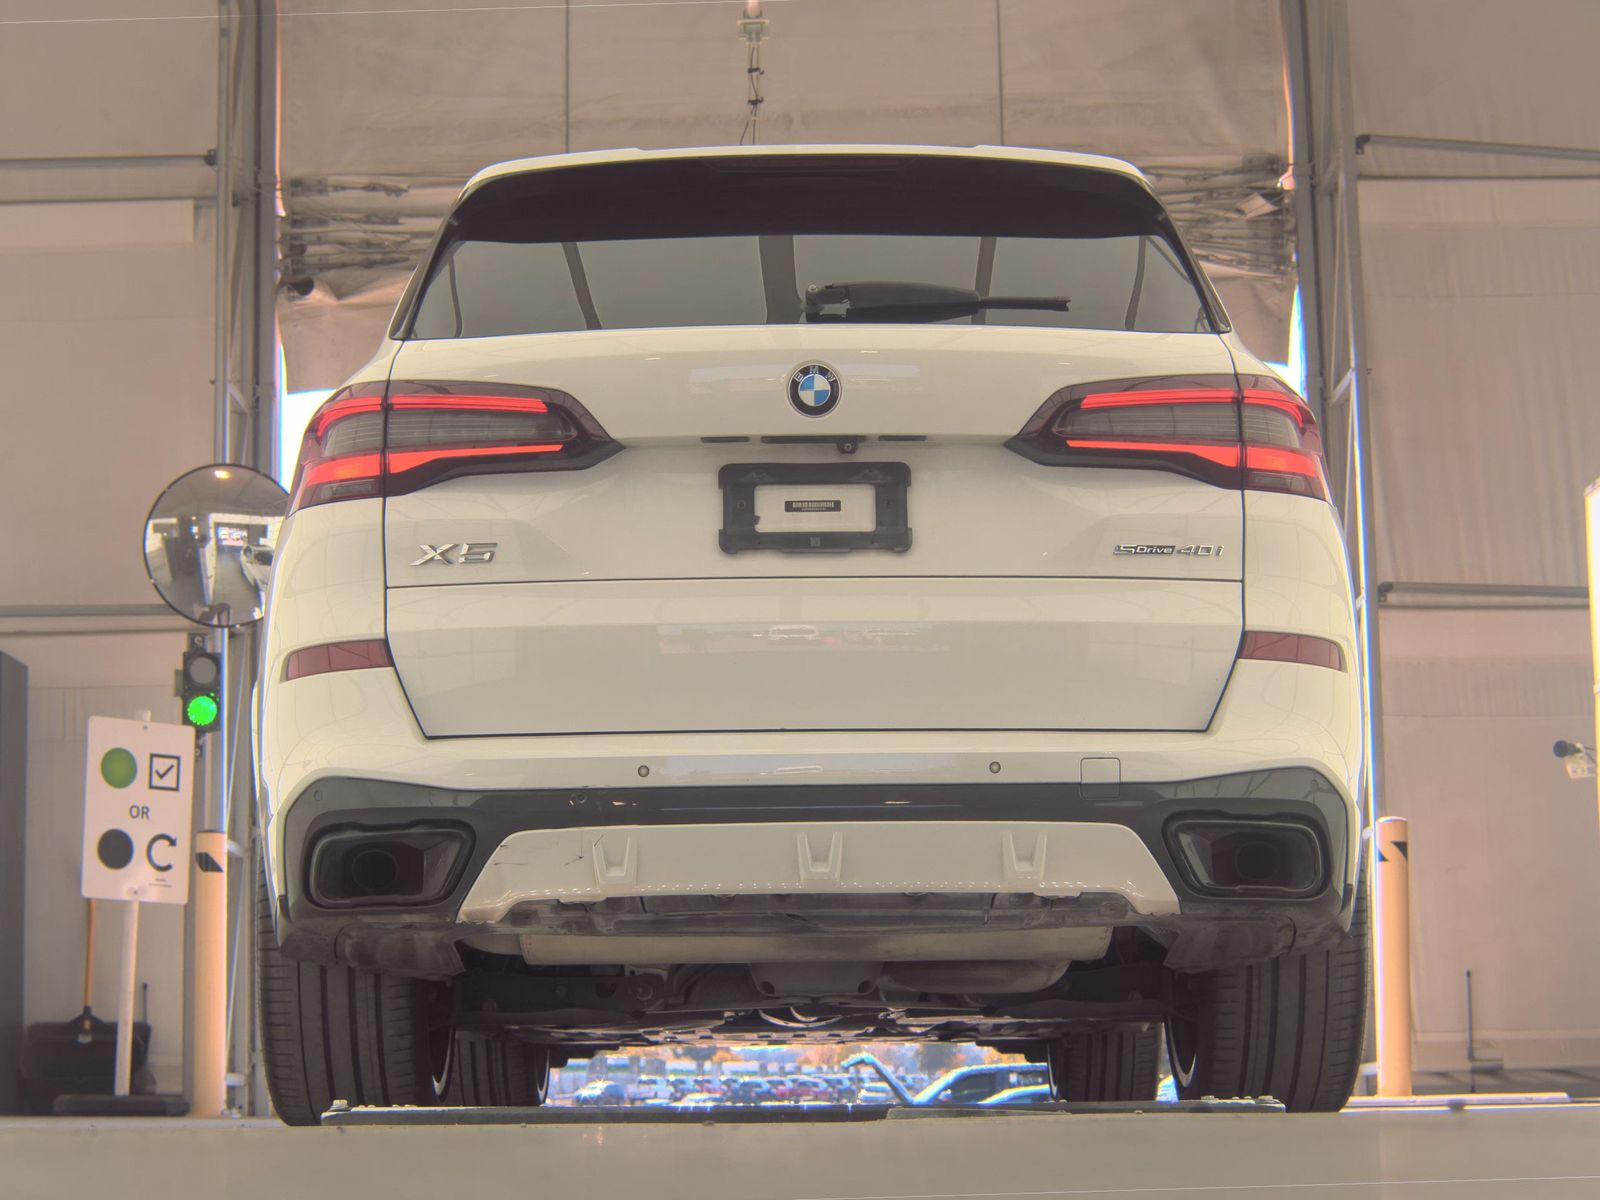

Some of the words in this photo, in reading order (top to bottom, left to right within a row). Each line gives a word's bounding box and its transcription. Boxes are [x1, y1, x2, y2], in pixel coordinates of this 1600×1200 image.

[793, 365, 836, 382] BMW
[409, 542, 498, 567] X5
[129, 804, 150, 820] OR
